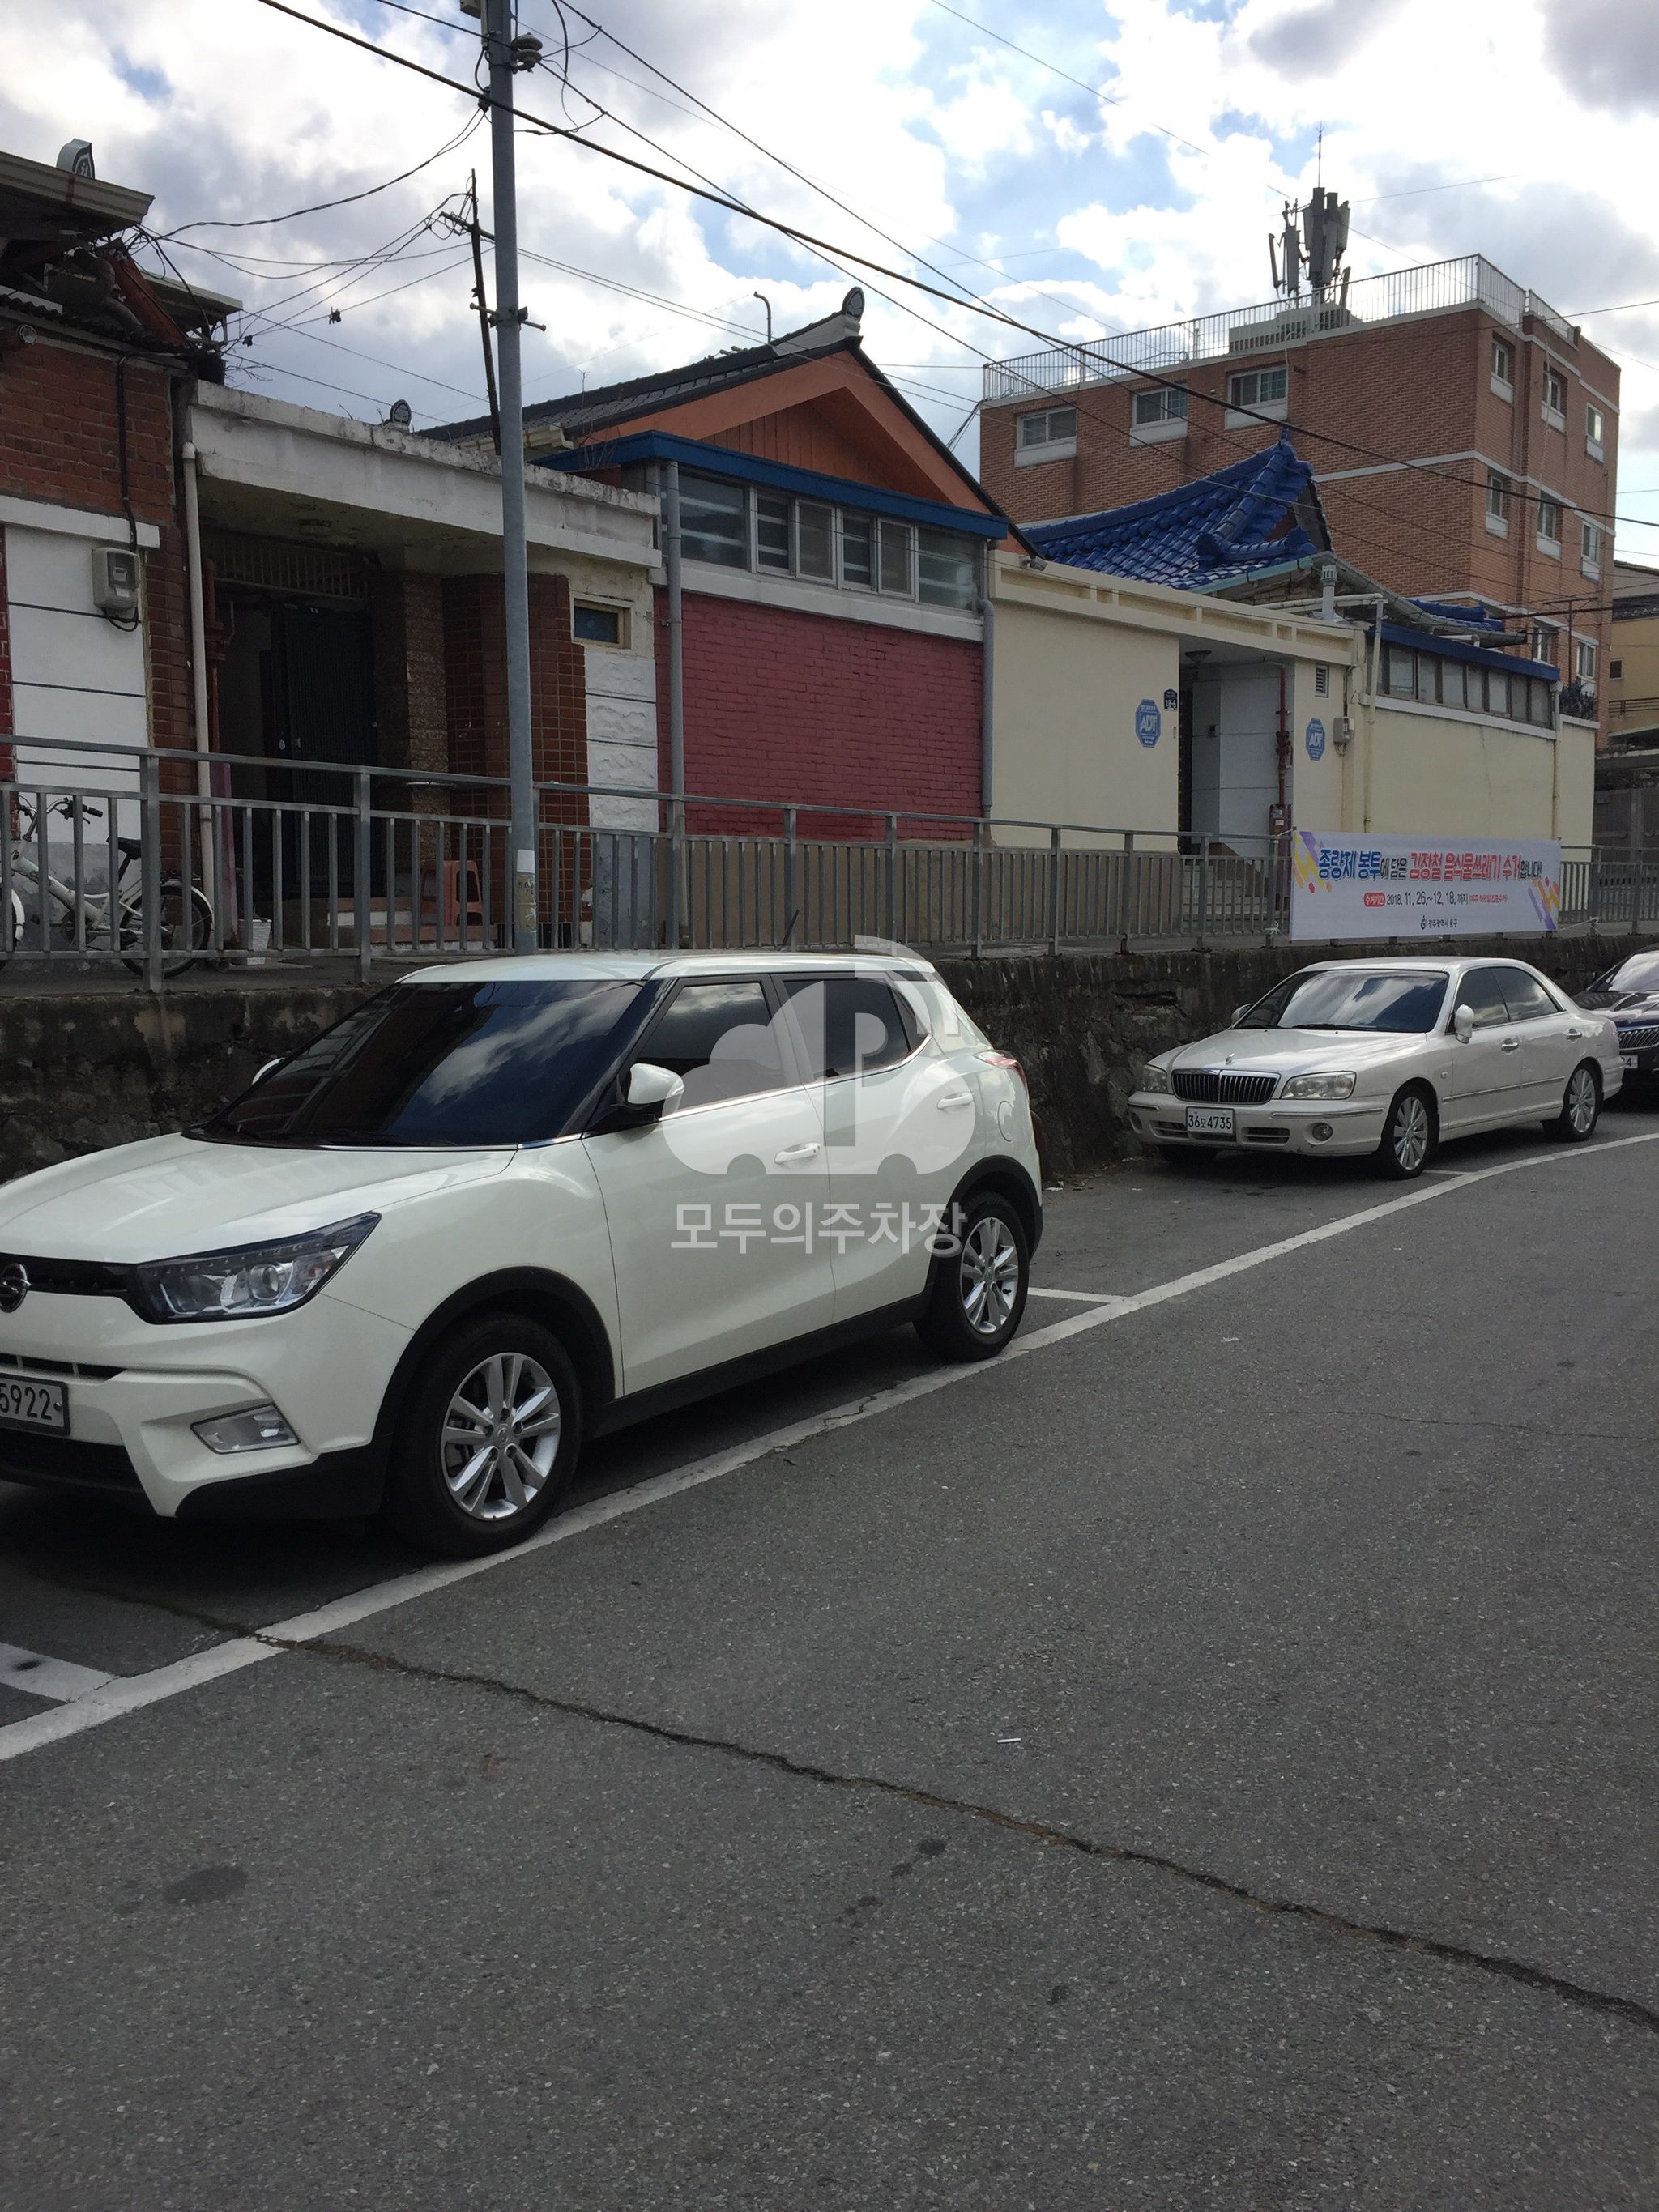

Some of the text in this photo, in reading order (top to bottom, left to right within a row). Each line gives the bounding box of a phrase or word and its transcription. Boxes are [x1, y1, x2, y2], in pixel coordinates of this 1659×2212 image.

[1141, 714, 1157, 731] ADT
[1309, 732, 1323, 747] ADT
[1319, 849, 1542, 881] 종량제 봉투에 담은 김장철 음식물쓰레기 수거합니다!
[0, 1382, 53, 1421] 5922
